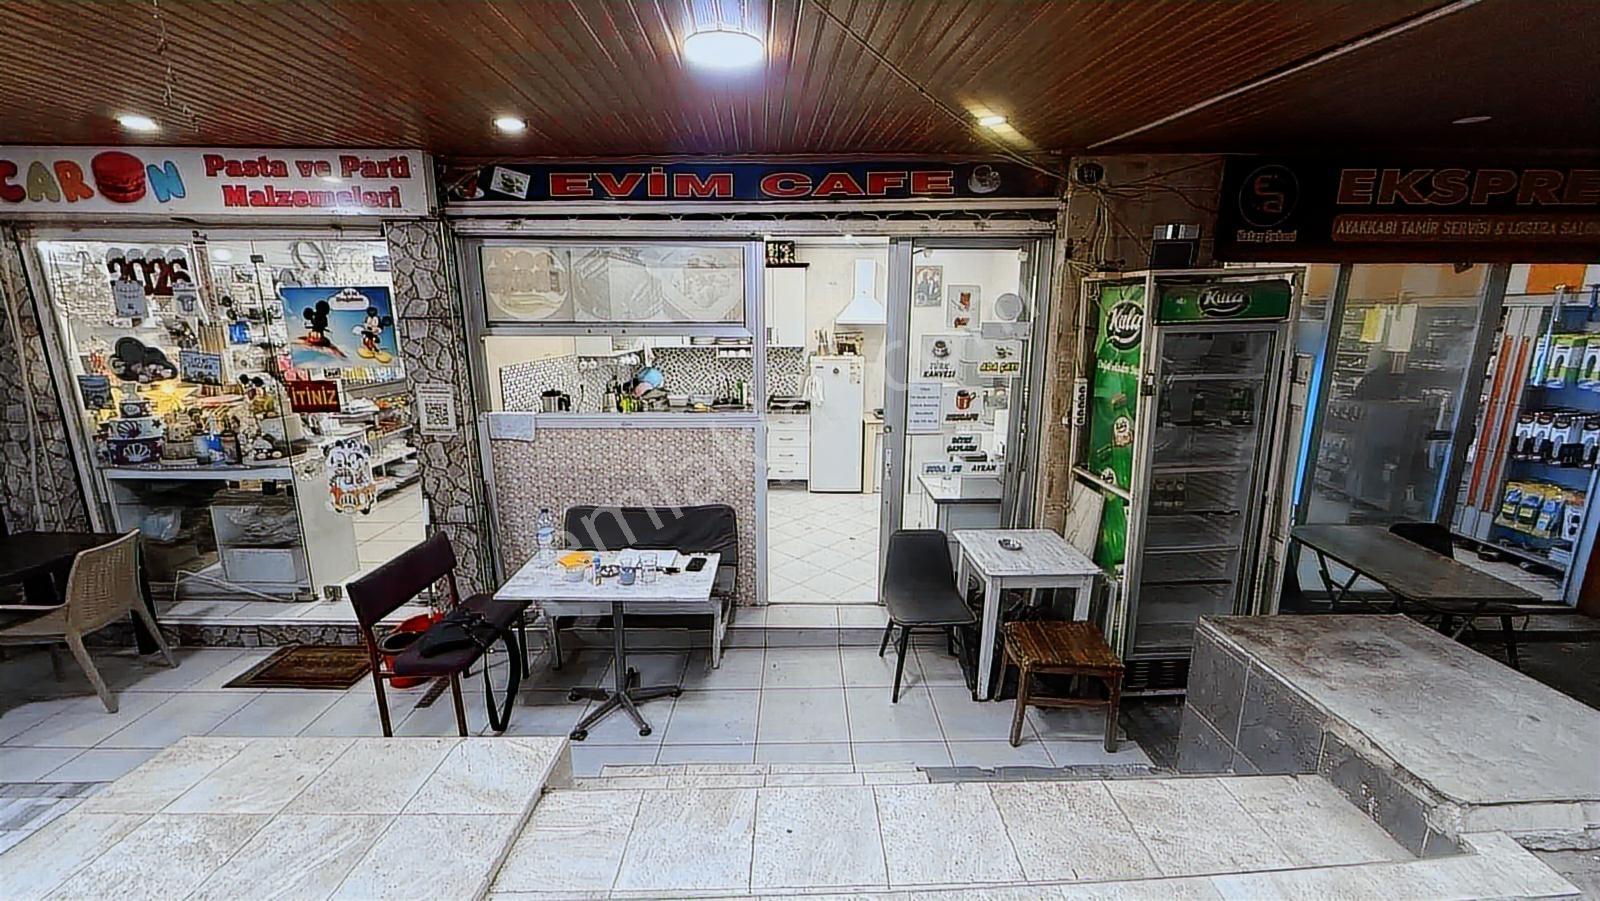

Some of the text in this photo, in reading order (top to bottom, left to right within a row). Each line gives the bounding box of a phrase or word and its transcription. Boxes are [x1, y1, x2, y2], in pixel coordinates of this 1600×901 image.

[202, 154, 412, 180] Pasta ve Parti
[548, 166, 956, 198] EVİM CAFE
[1336, 168, 1600, 206] EKSPRE
[222, 184, 403, 209] Malzemeleri
[1336, 218, 1397, 236] AYAKKABI
[1400, 217, 1440, 236] TAMİR
[1108, 306, 1143, 333] Kula
[929, 359, 951, 370] TÜRK
[291, 386, 338, 406] İTİNİZ
[971, 464, 997, 472] AYRAN
